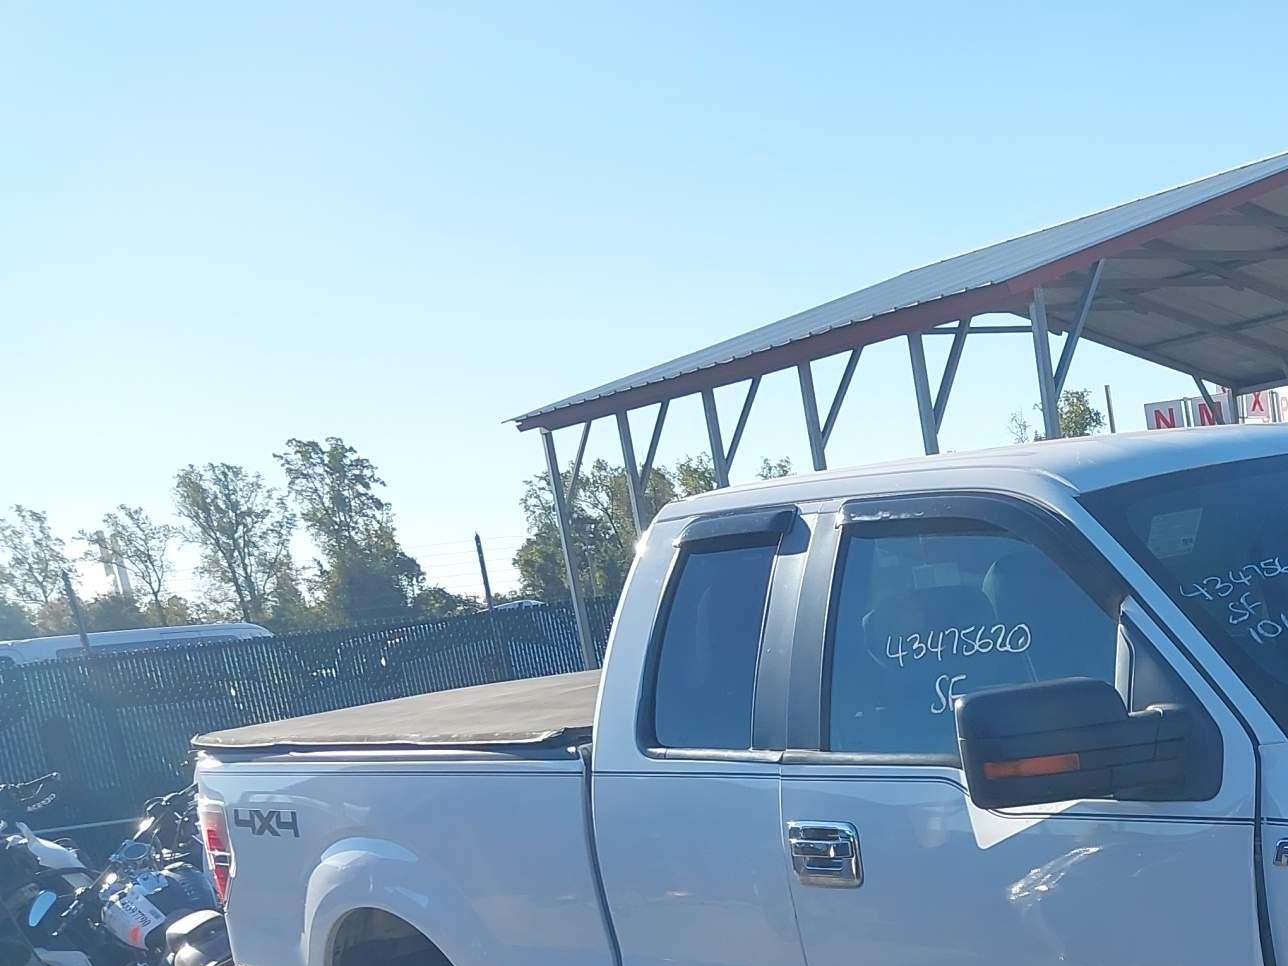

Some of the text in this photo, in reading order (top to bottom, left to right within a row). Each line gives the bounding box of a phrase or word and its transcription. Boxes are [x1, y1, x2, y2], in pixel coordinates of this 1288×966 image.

[1154, 407, 1175, 429] N
[1228, 592, 1262, 625] SF
[886, 623, 1032, 667] 43475620
[930, 674, 967, 714] SF
